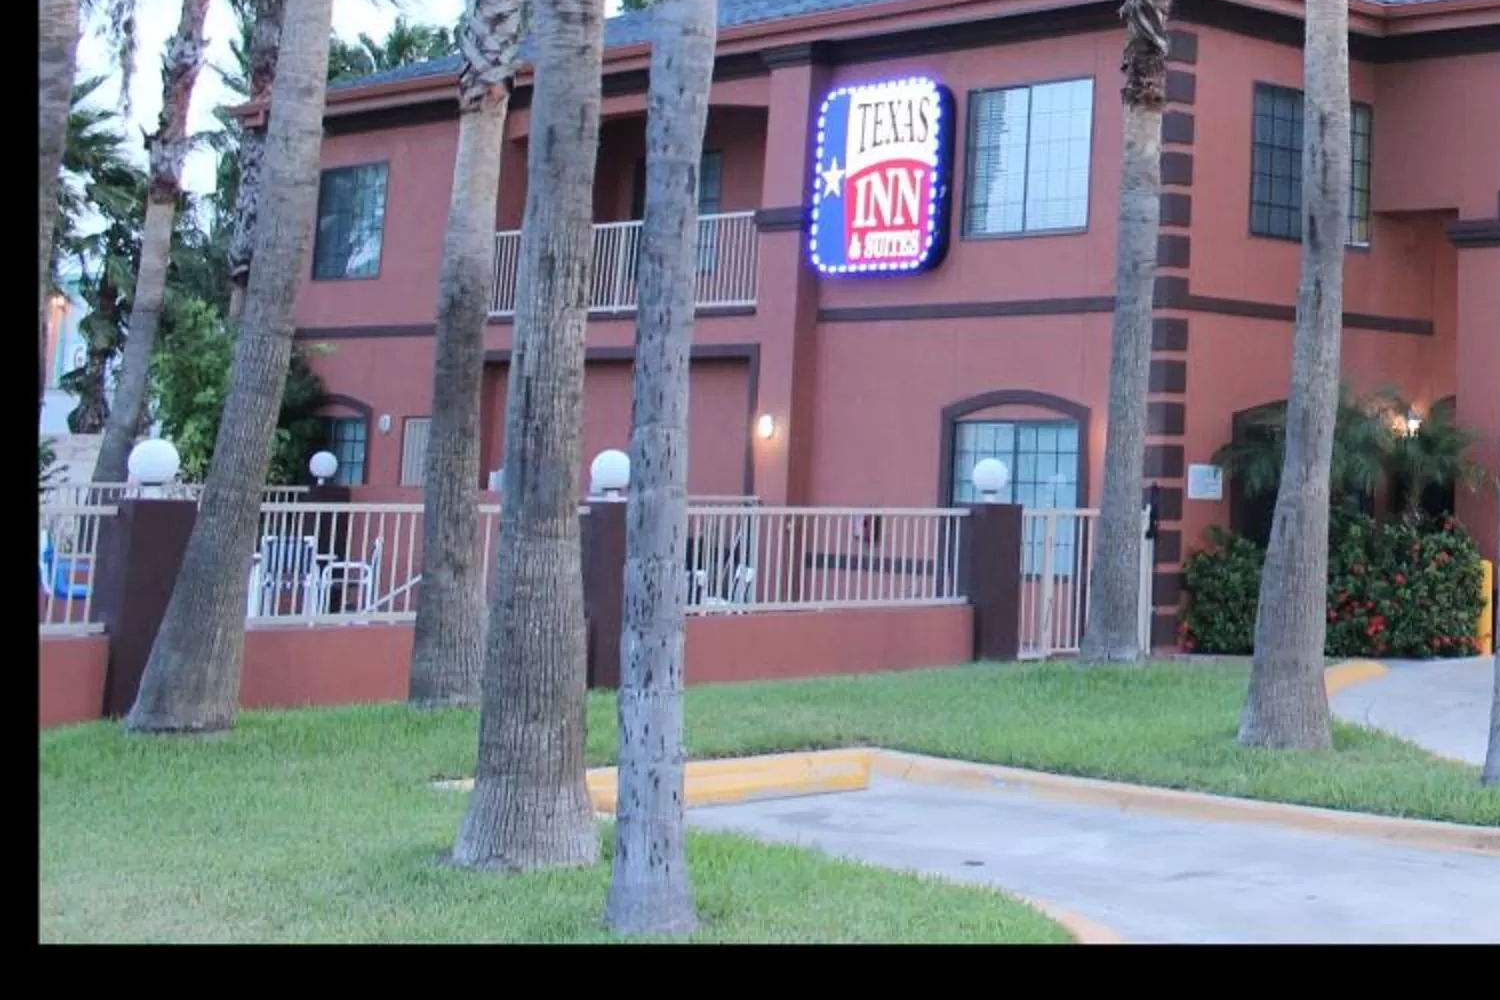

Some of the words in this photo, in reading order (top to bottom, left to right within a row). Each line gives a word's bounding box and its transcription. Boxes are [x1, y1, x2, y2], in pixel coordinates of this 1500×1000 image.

[857, 96, 931, 153] TEXAS
[853, 168, 925, 228] INN
[863, 230, 921, 259] SUITES
